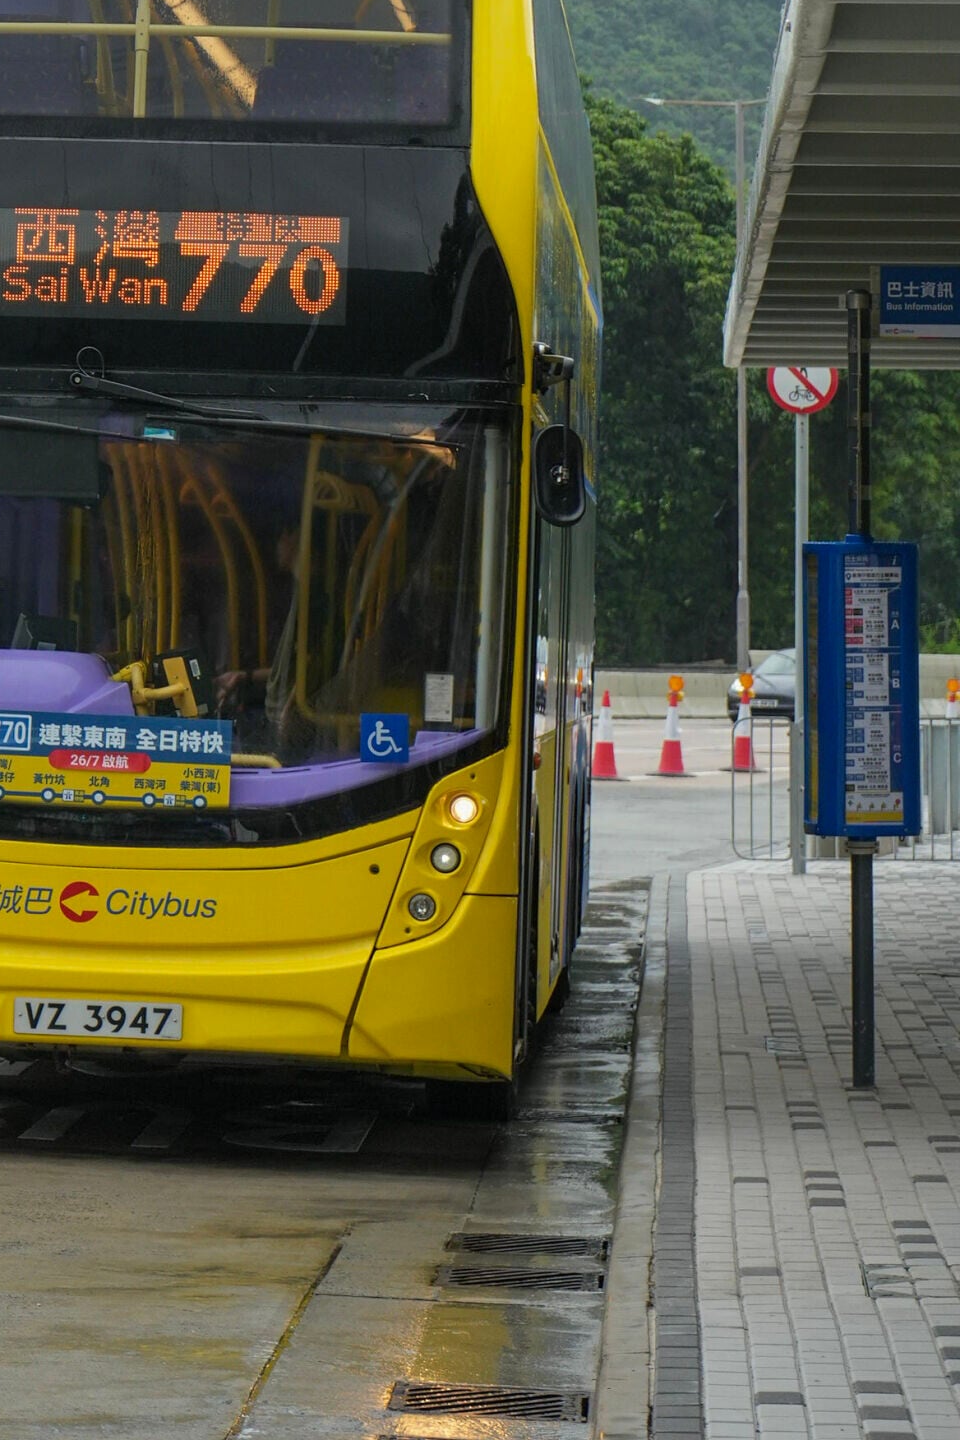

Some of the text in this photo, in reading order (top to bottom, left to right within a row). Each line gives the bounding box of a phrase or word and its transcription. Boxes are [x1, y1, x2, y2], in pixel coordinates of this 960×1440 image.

[2, 266, 68, 303] Sai
[79, 266, 168, 305] Wan
[180, 243, 340, 315] 770
[887, 281, 954, 298] 巴士資訊
[886, 302, 954, 311] Bus Information
[38, 723, 223, 753] 連繫東南 全日特快
[70, 754, 100, 767] 26/7
[33, 773, 65, 785] 黃竹坑
[89, 775, 110, 788] 北角
[134, 777, 166, 790] 西灣河
[106, 889, 218, 919] Citybus
[25, 1002, 173, 1035] VZ 3947
